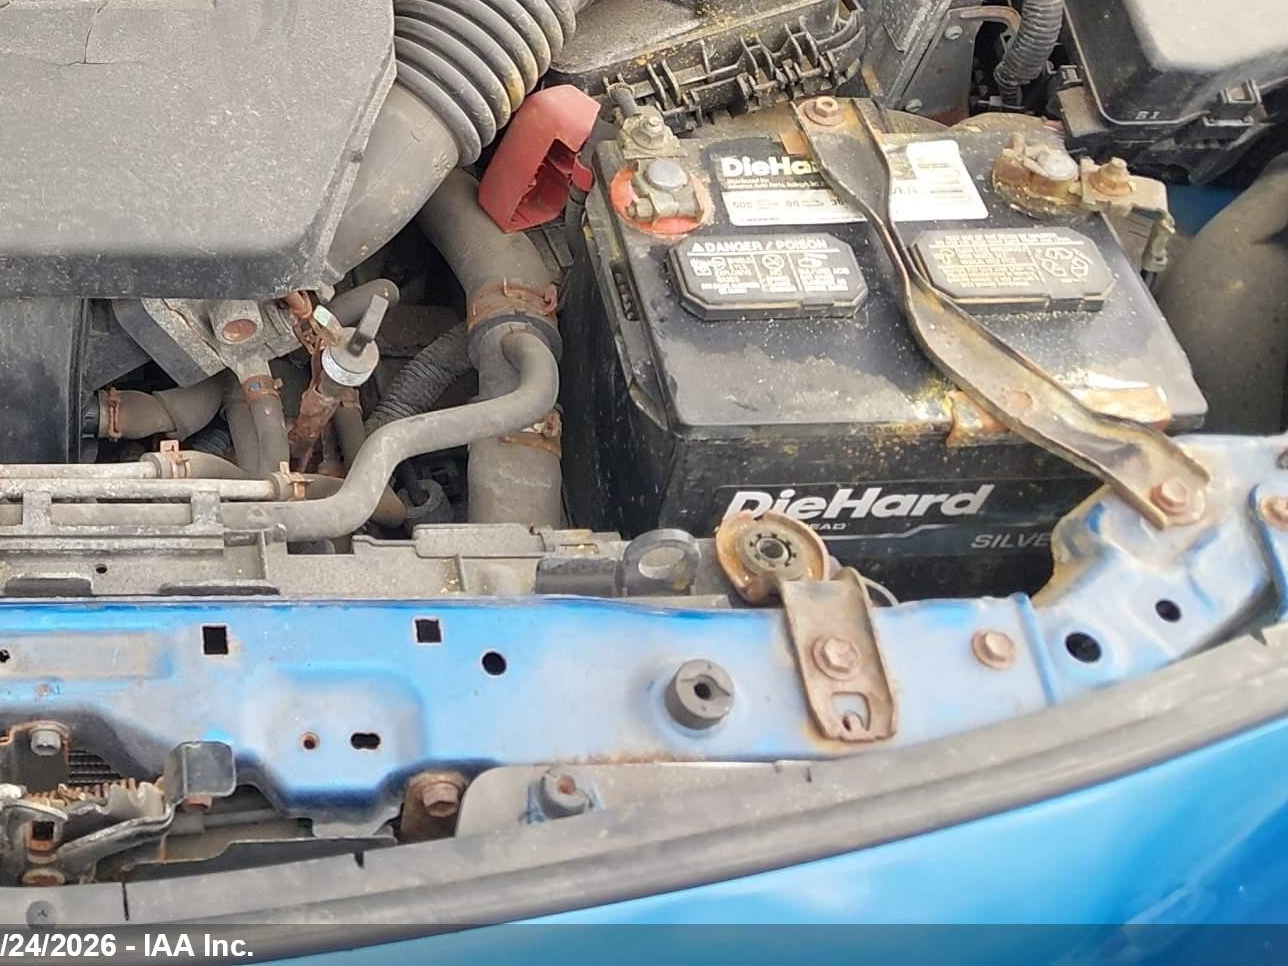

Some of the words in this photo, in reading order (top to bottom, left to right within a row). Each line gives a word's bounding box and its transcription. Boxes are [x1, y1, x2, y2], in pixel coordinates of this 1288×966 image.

[721, 156, 820, 177] DieHa
[705, 242, 763, 252] DANGER
[776, 239, 827, 250] POISON
[723, 484, 995, 519] DieHard
[971, 533, 1050, 548] SILVE
